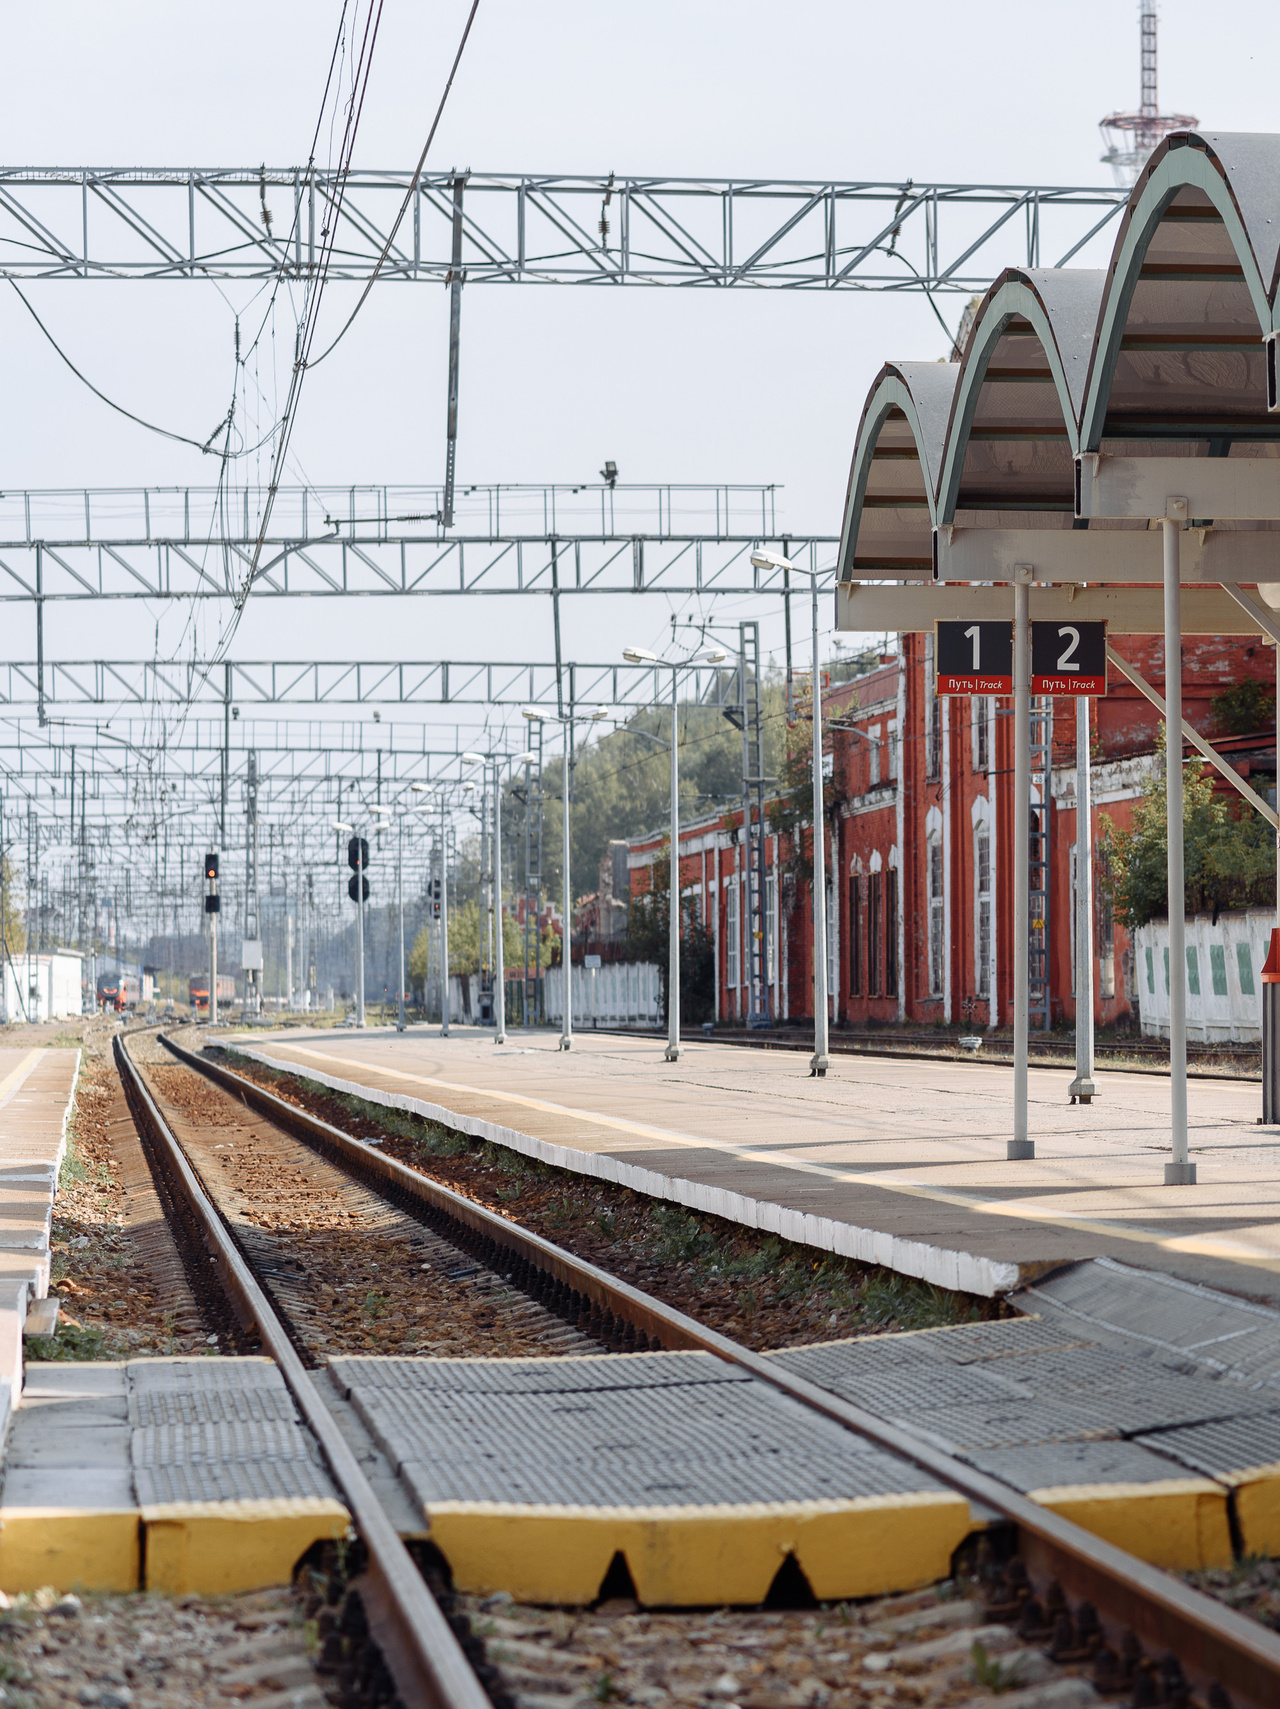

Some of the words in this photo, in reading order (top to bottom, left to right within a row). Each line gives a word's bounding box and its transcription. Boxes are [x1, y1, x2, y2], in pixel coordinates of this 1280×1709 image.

[963, 625, 980, 670] 1
[1057, 626, 1080, 671] 2
[948, 679, 974, 691] Путь
[979, 681, 1003, 689] Track
[1042, 679, 1066, 691] Путь
[1072, 681, 1096, 689] Track
